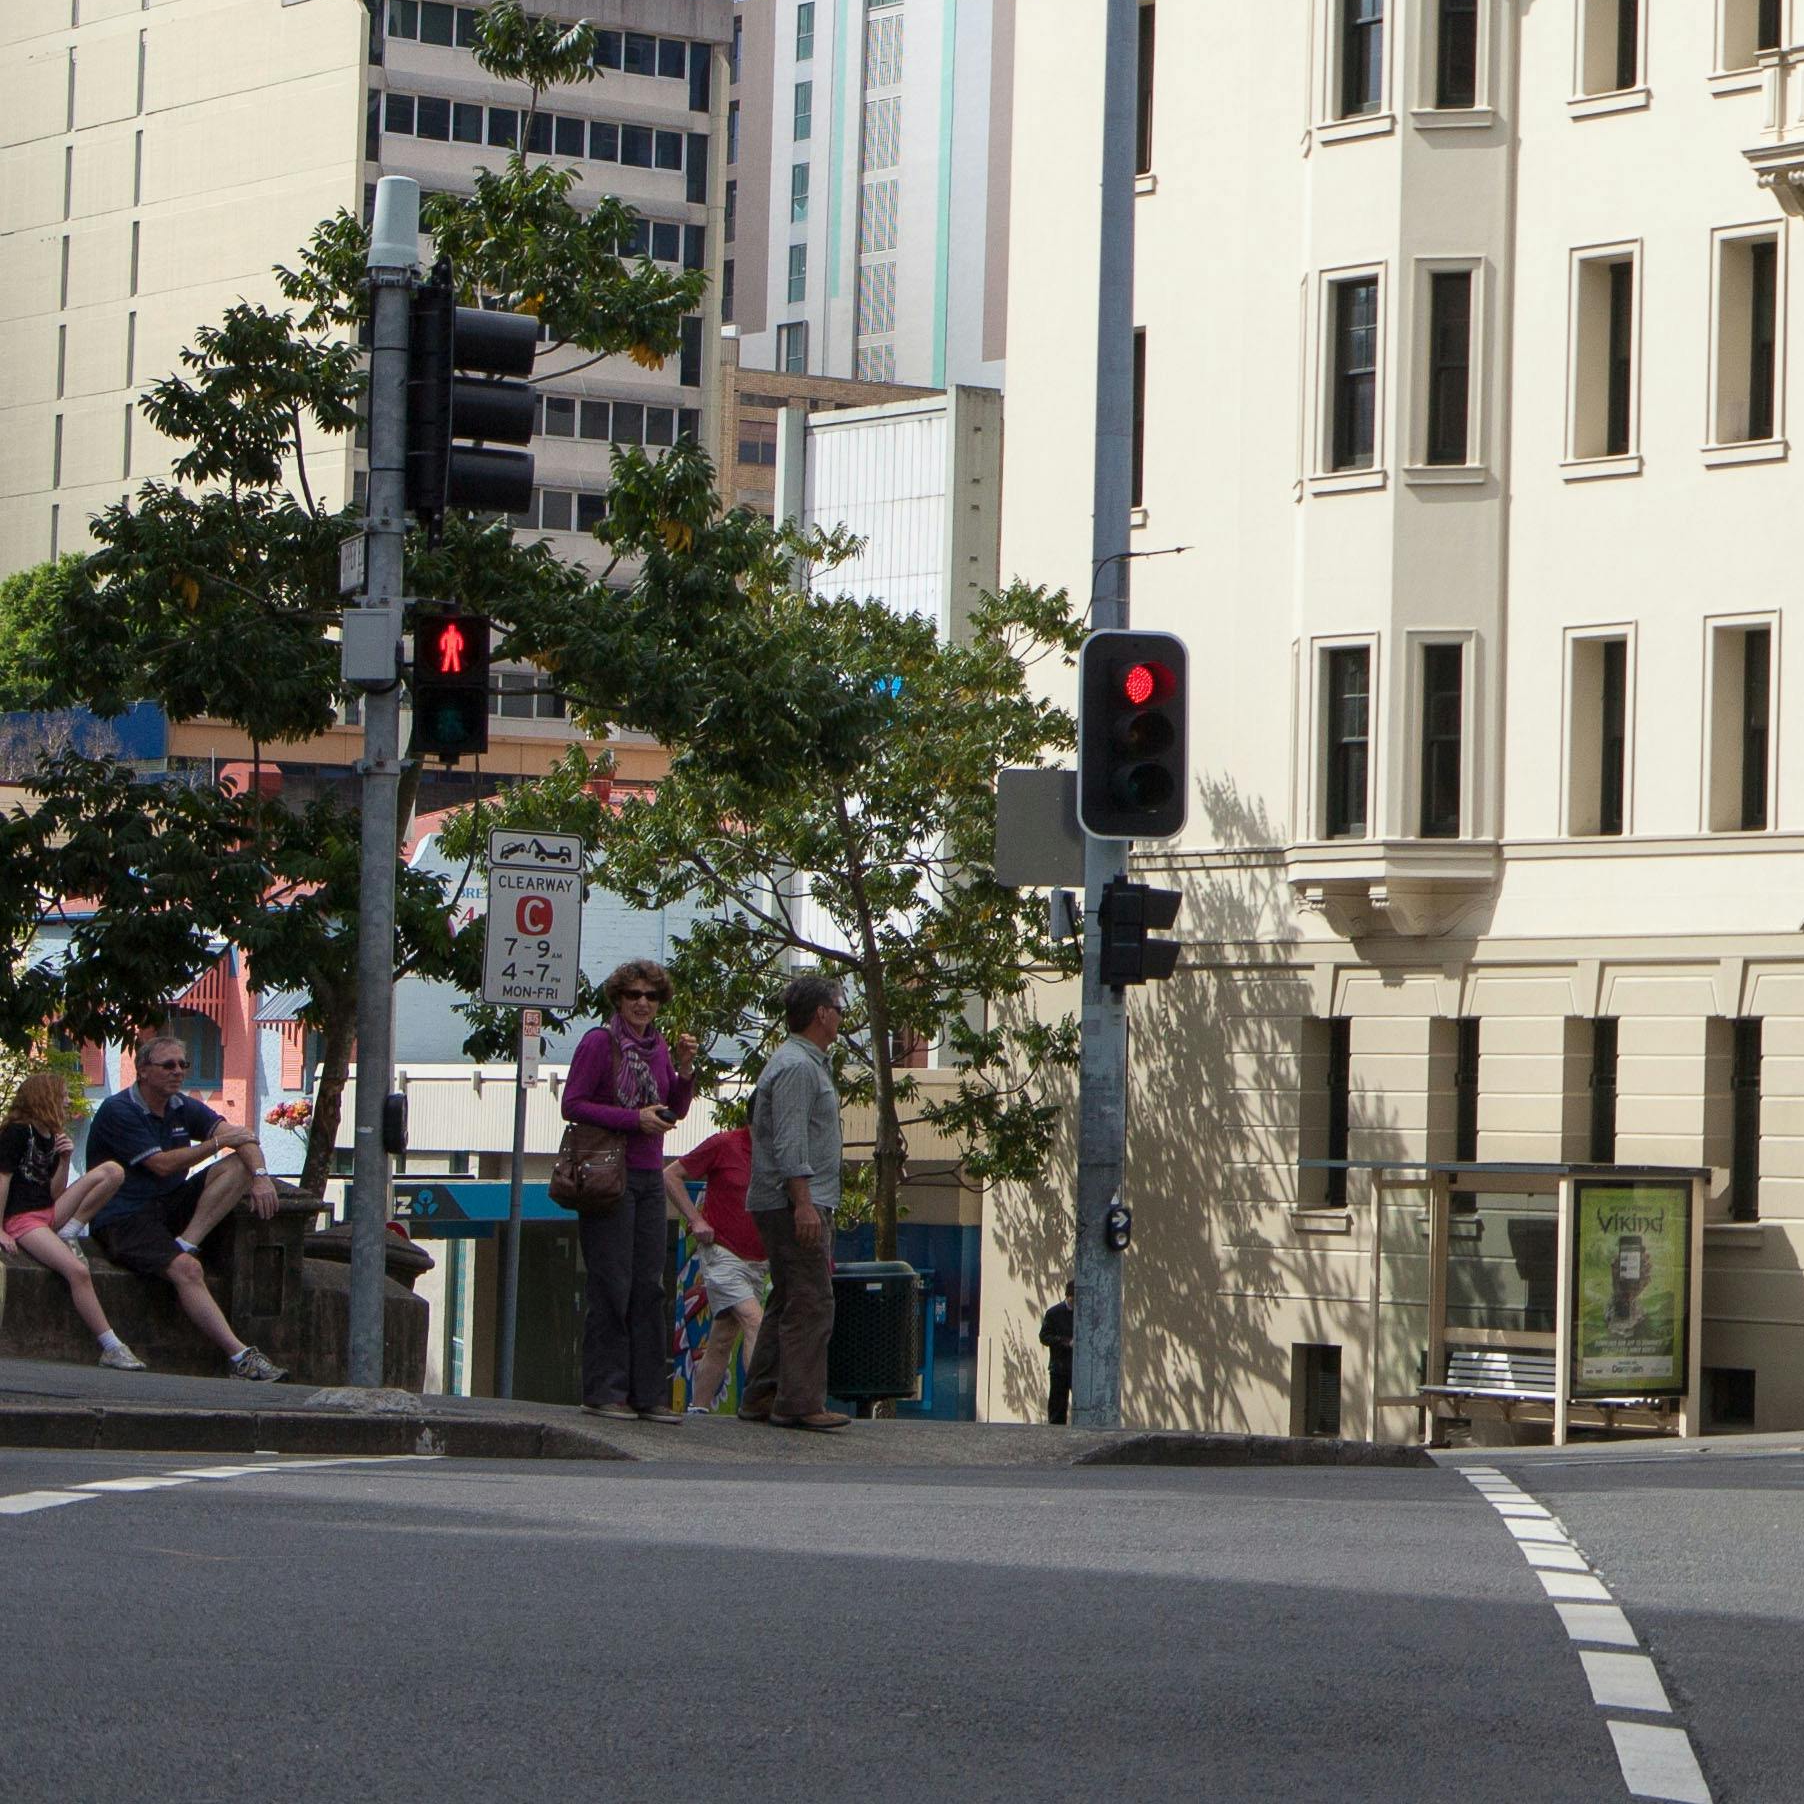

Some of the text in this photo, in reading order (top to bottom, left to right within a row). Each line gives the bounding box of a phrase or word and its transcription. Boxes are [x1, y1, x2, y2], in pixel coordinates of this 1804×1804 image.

[499, 875, 573, 893] CLEARWAY
[503, 986, 558, 1000] MON-FRI
[524, 1025, 540, 1037] ZONE
